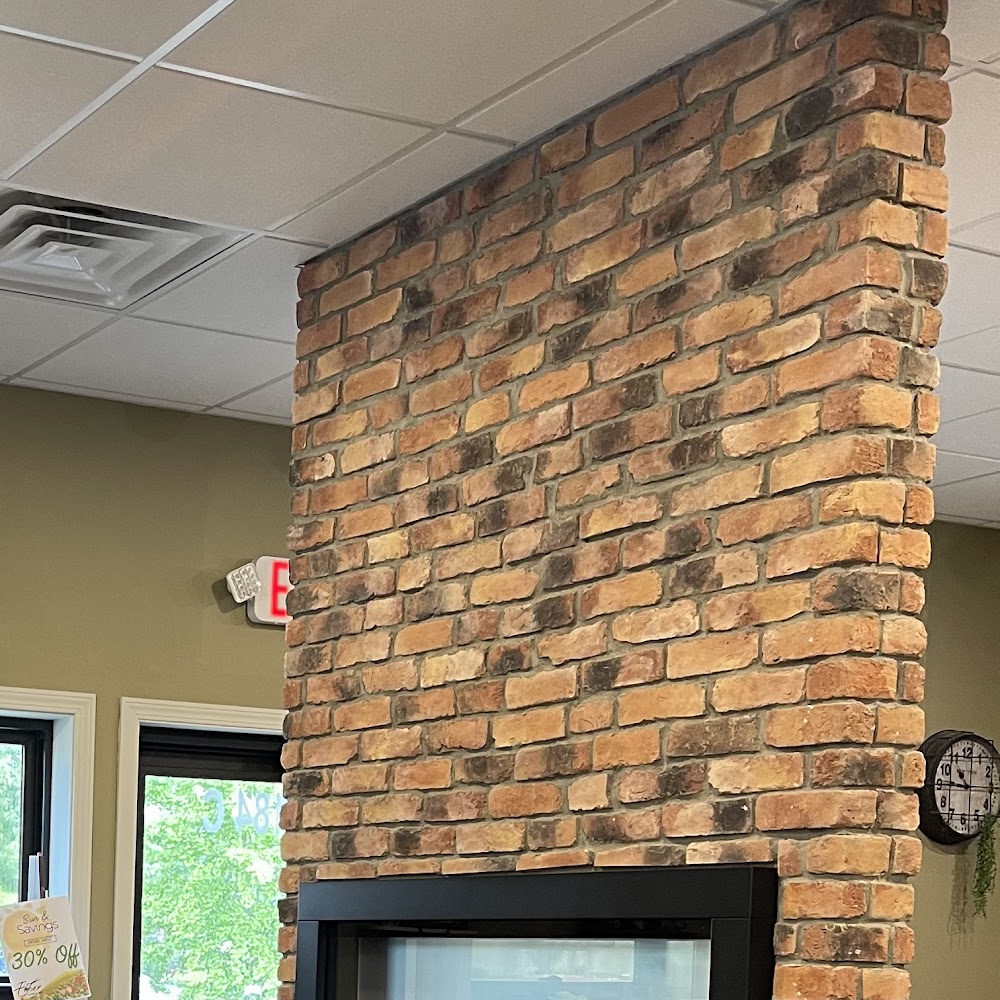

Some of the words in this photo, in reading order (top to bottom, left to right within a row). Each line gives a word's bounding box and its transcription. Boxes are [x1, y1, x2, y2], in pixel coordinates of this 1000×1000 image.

[272, 561, 289, 616] E
[985, 765, 991, 778] 2
[940, 795, 947, 808] 8
[22, 913, 39, 925] Sun
[16, 921, 60, 935] Savings
[11, 948, 48, 970] 30%
[55, 943, 80, 969] Off
